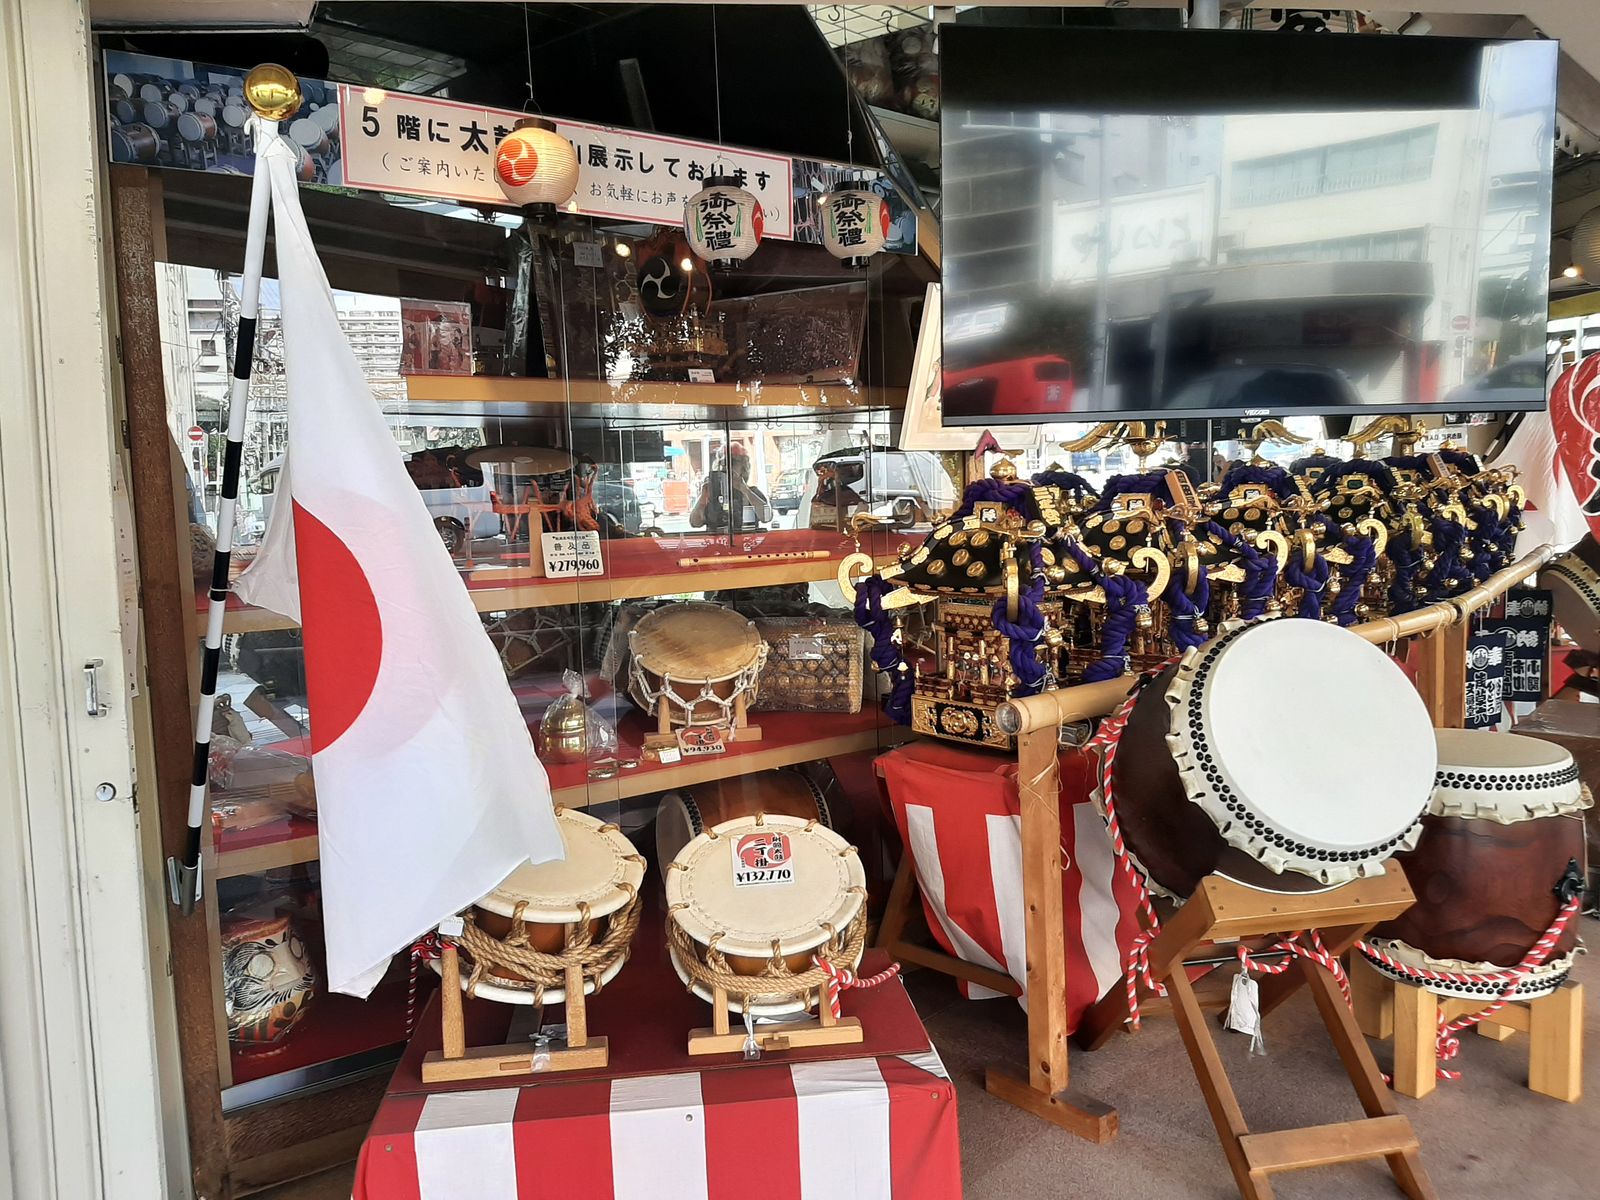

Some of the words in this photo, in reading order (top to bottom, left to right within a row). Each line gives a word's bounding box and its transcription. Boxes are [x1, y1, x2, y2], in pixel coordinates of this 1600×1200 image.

[700, 192, 736, 251] 御祭禮
[833, 193, 867, 247] 御祭禮
[548, 559, 600, 572] ¥279,960
[683, 745, 722, 753] ¥94,930
[737, 869, 791, 882] ¥132,770
